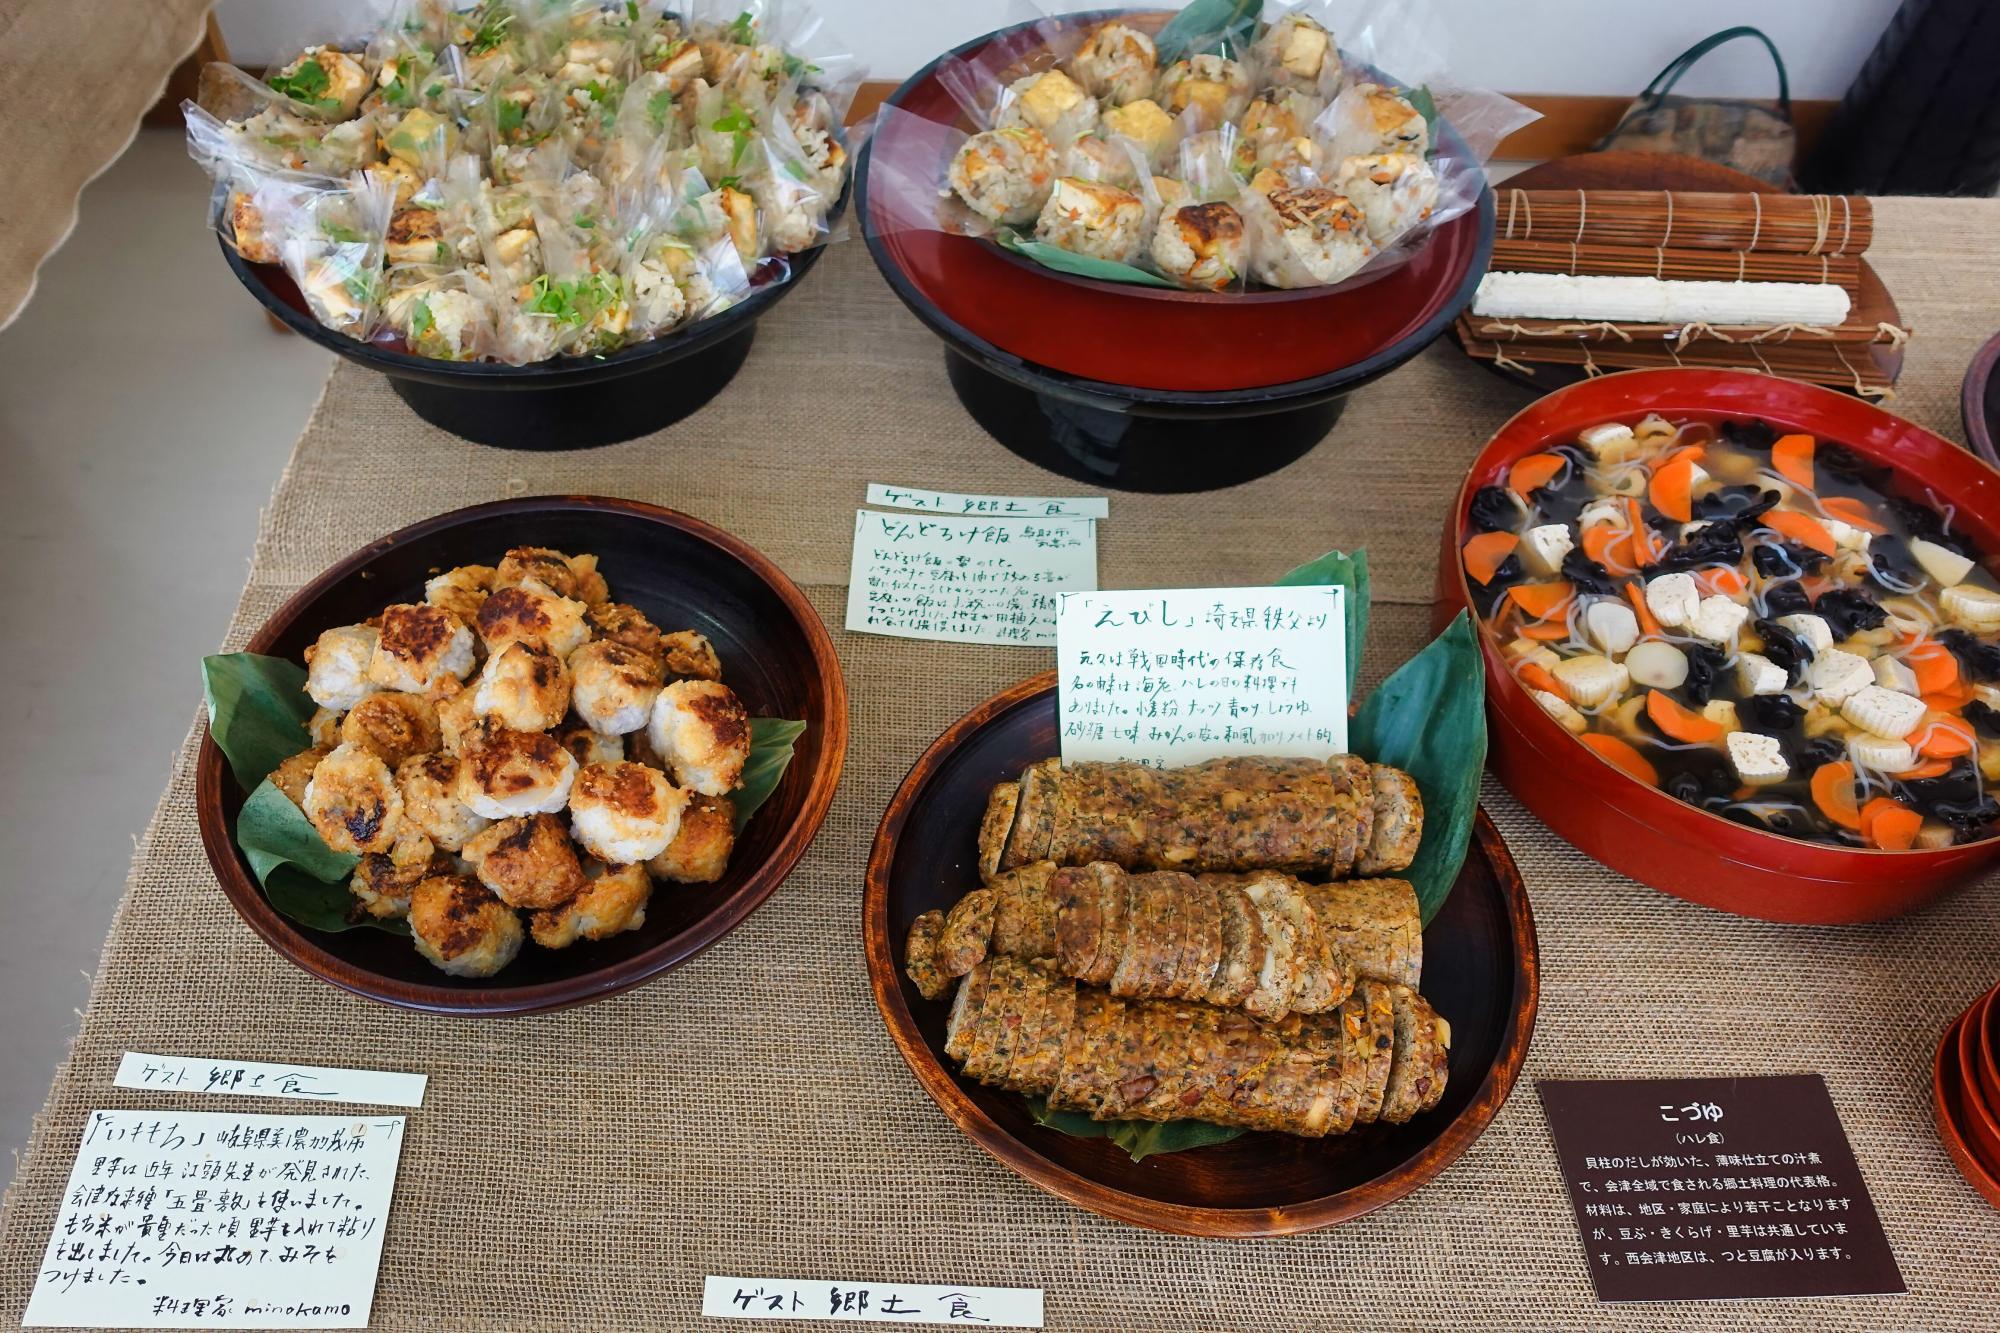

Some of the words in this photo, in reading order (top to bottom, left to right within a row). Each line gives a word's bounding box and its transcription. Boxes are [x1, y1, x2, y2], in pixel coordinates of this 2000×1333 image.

[886, 489, 945, 507] ゲスト
[963, 499, 1080, 516] 郷土食
[142, 1062, 189, 1084] ゲスト
[204, 1066, 340, 1095] 郷土食
[1659, 1101, 1724, 1123] こづゆ
[1585, 1151, 1823, 1170] 貝柱のだしが効いた、薄味仕立ての汁煮
[1578, 1174, 1838, 1193] で、会津全域で食される郷土料理の代表格。
[1585, 1197, 1851, 1217] 材料は、地区・家庭により若干ことなります
[1592, 1222, 1849, 1241] が、豆ぶ・きくらげ・里芋は共通していま
[1599, 1246, 1852, 1266] す。西会津地区は、つと豆腐が入ります。
[43, 1267, 147, 1294] つけました。
[153, 1294, 233, 1318] 料理家
[245, 1302, 351, 1317] minokamo
[732, 1286, 806, 1312] ゲスト
[829, 1285, 991, 1322] 郷土食
